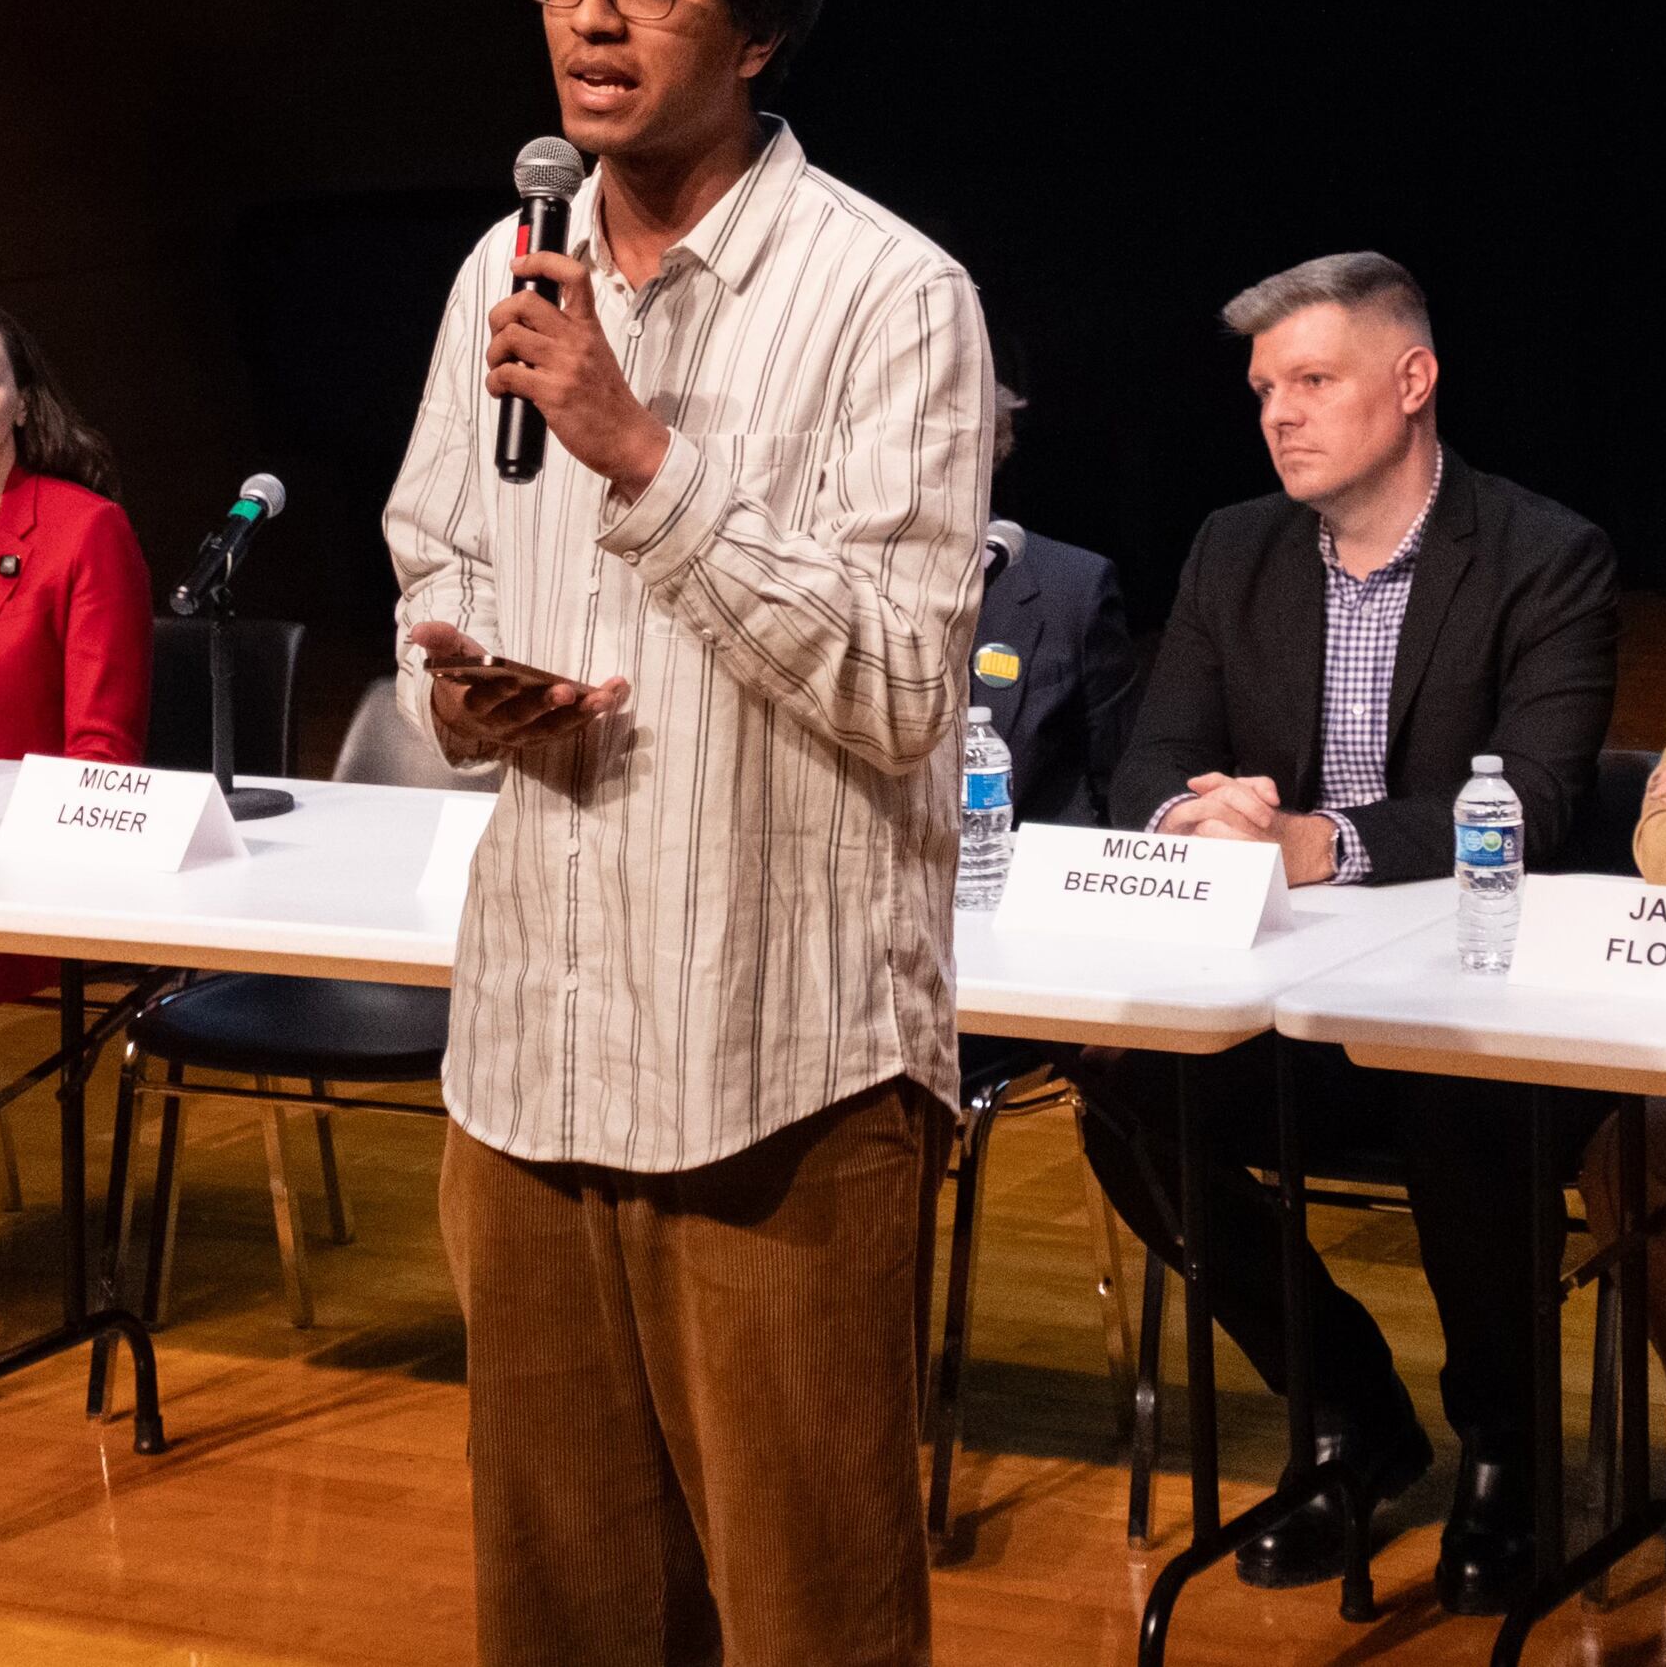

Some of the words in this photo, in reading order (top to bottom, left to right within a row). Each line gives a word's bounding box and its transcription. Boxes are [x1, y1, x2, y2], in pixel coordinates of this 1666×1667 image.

[78, 766, 151, 795] MICAH
[57, 803, 147, 834] LASHER
[1102, 837, 1189, 864] MICAH
[1063, 871, 1212, 901] BERGDALE
